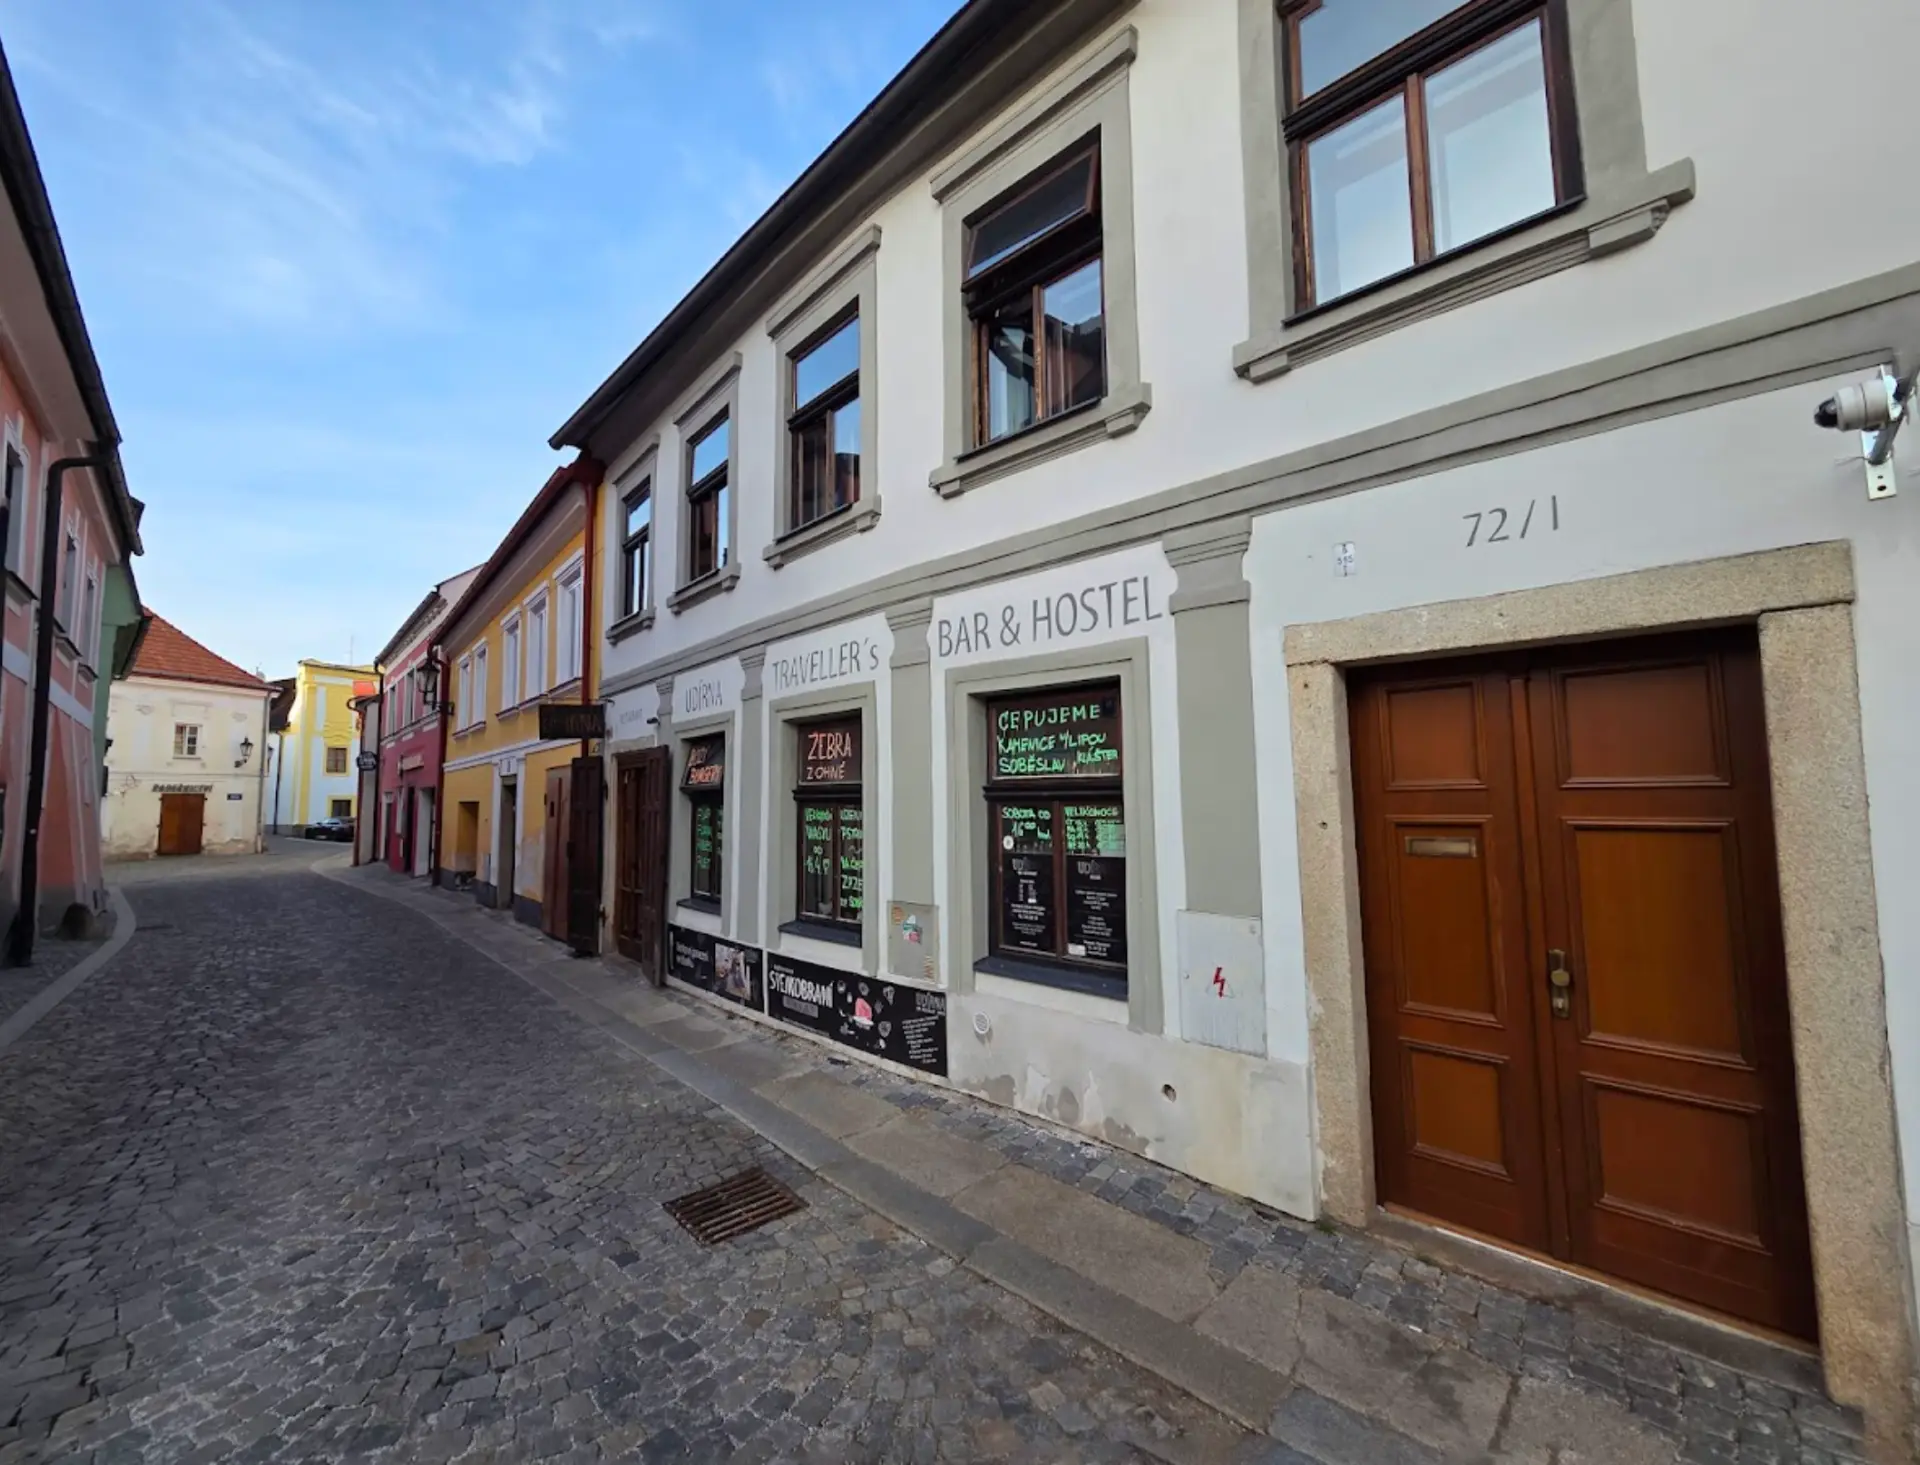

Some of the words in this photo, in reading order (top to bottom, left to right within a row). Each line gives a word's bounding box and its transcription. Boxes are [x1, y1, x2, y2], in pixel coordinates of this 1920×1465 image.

[938, 612, 991, 658] BAR
[999, 605, 1021, 647] &
[1032, 575, 1163, 642] HOSTEL
[997, 735, 1056, 755] KAMENICE
[999, 753, 1066, 774] SOBĚSLAV
